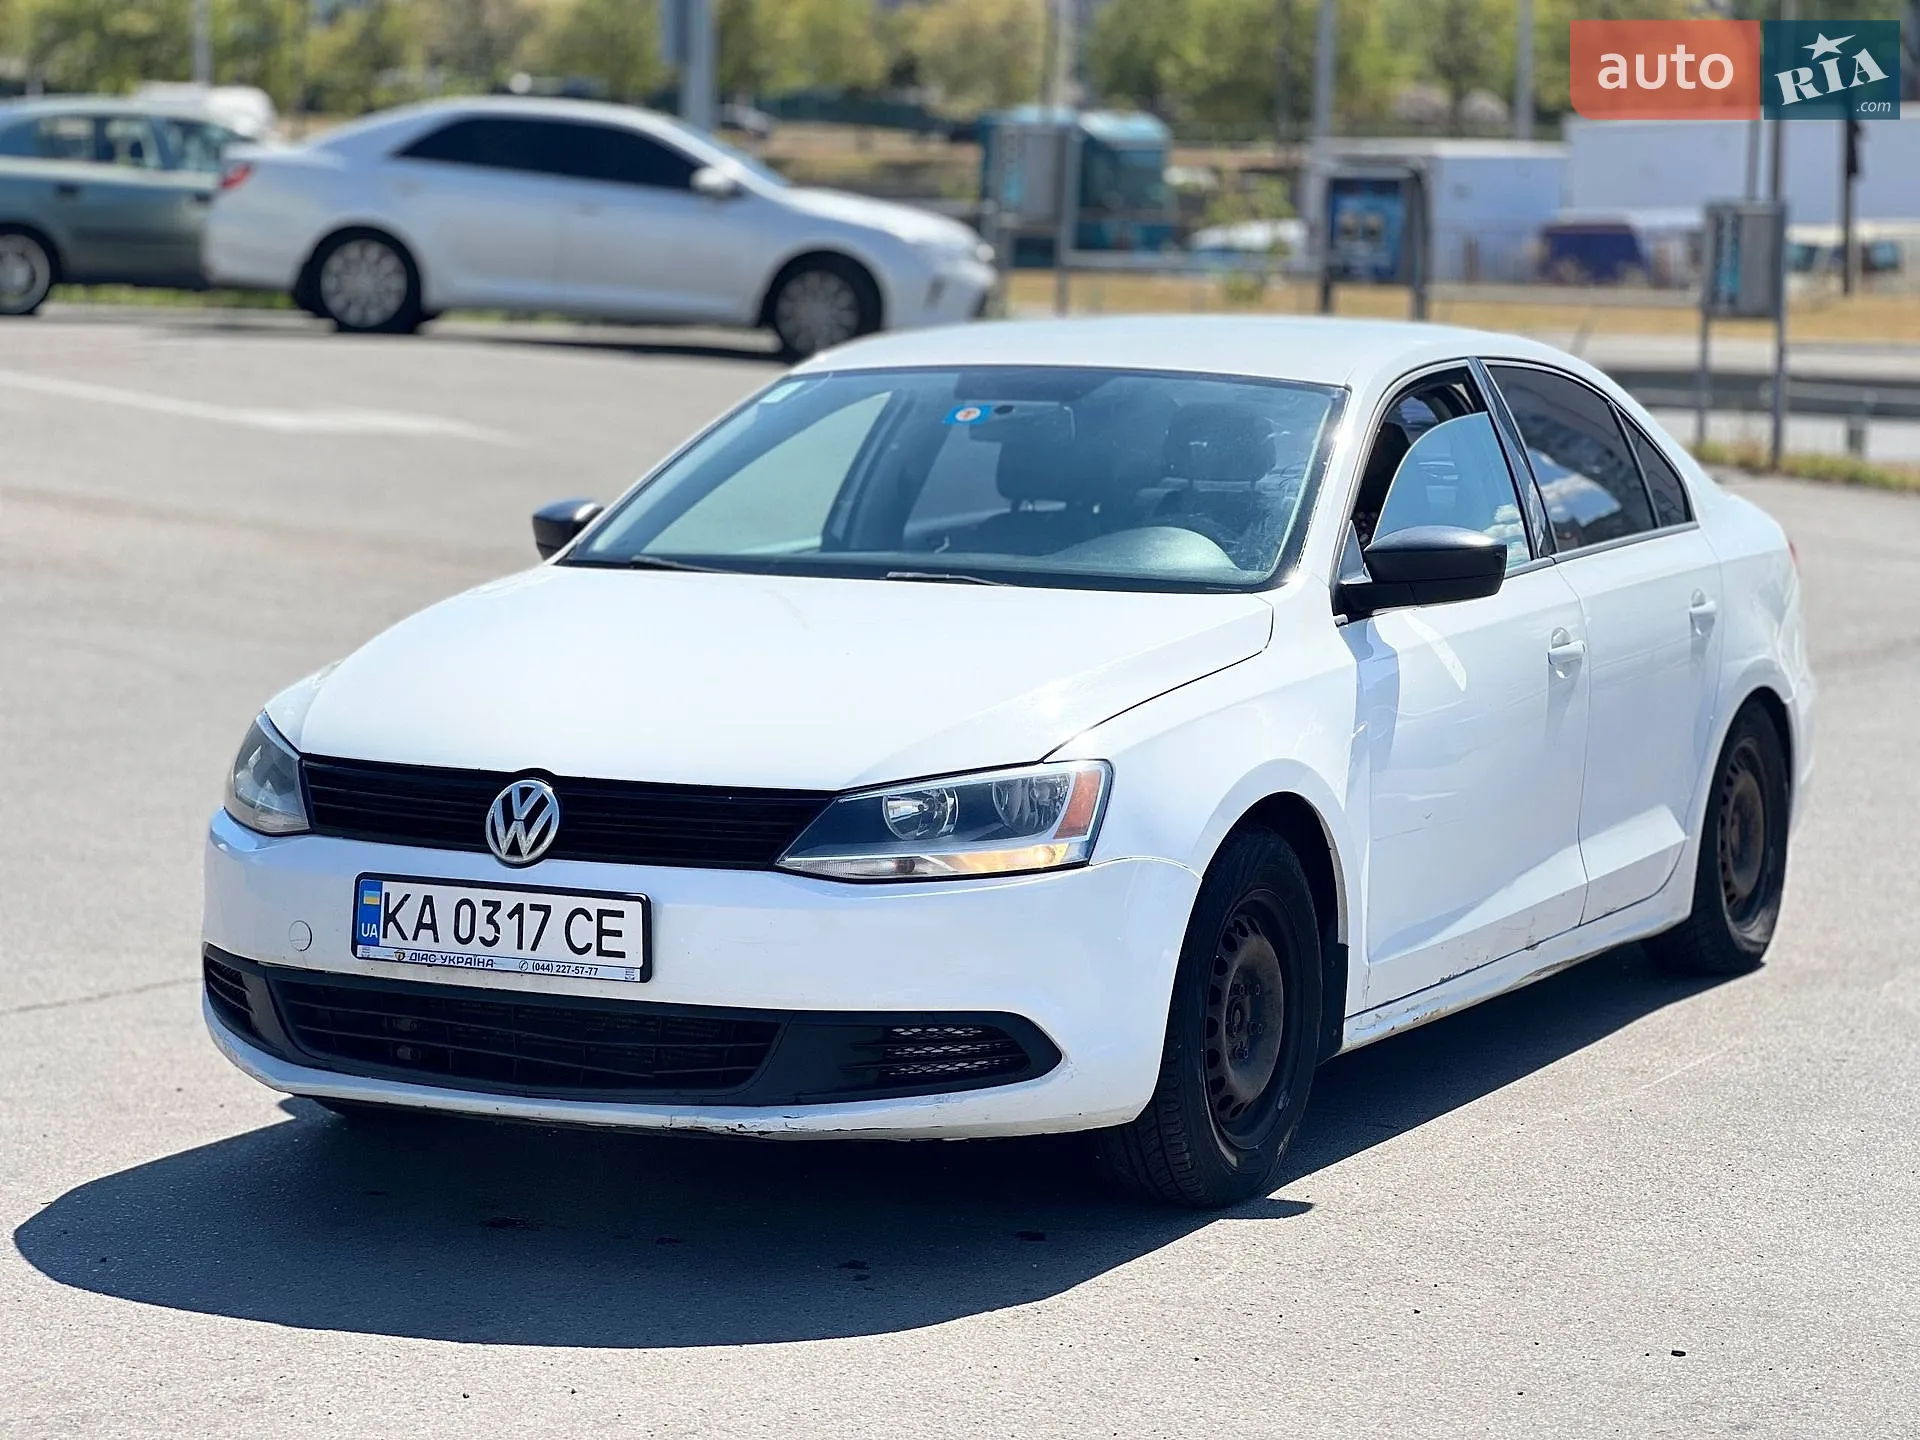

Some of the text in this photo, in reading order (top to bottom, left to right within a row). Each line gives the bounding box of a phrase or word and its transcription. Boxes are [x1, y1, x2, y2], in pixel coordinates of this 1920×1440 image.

[361, 923, 378, 938] UA
[453, 898, 551, 951] 0317
[440, 954, 495, 968] УКРАЇНА
[532, 961, 599, 976] (044) 227-57-77
